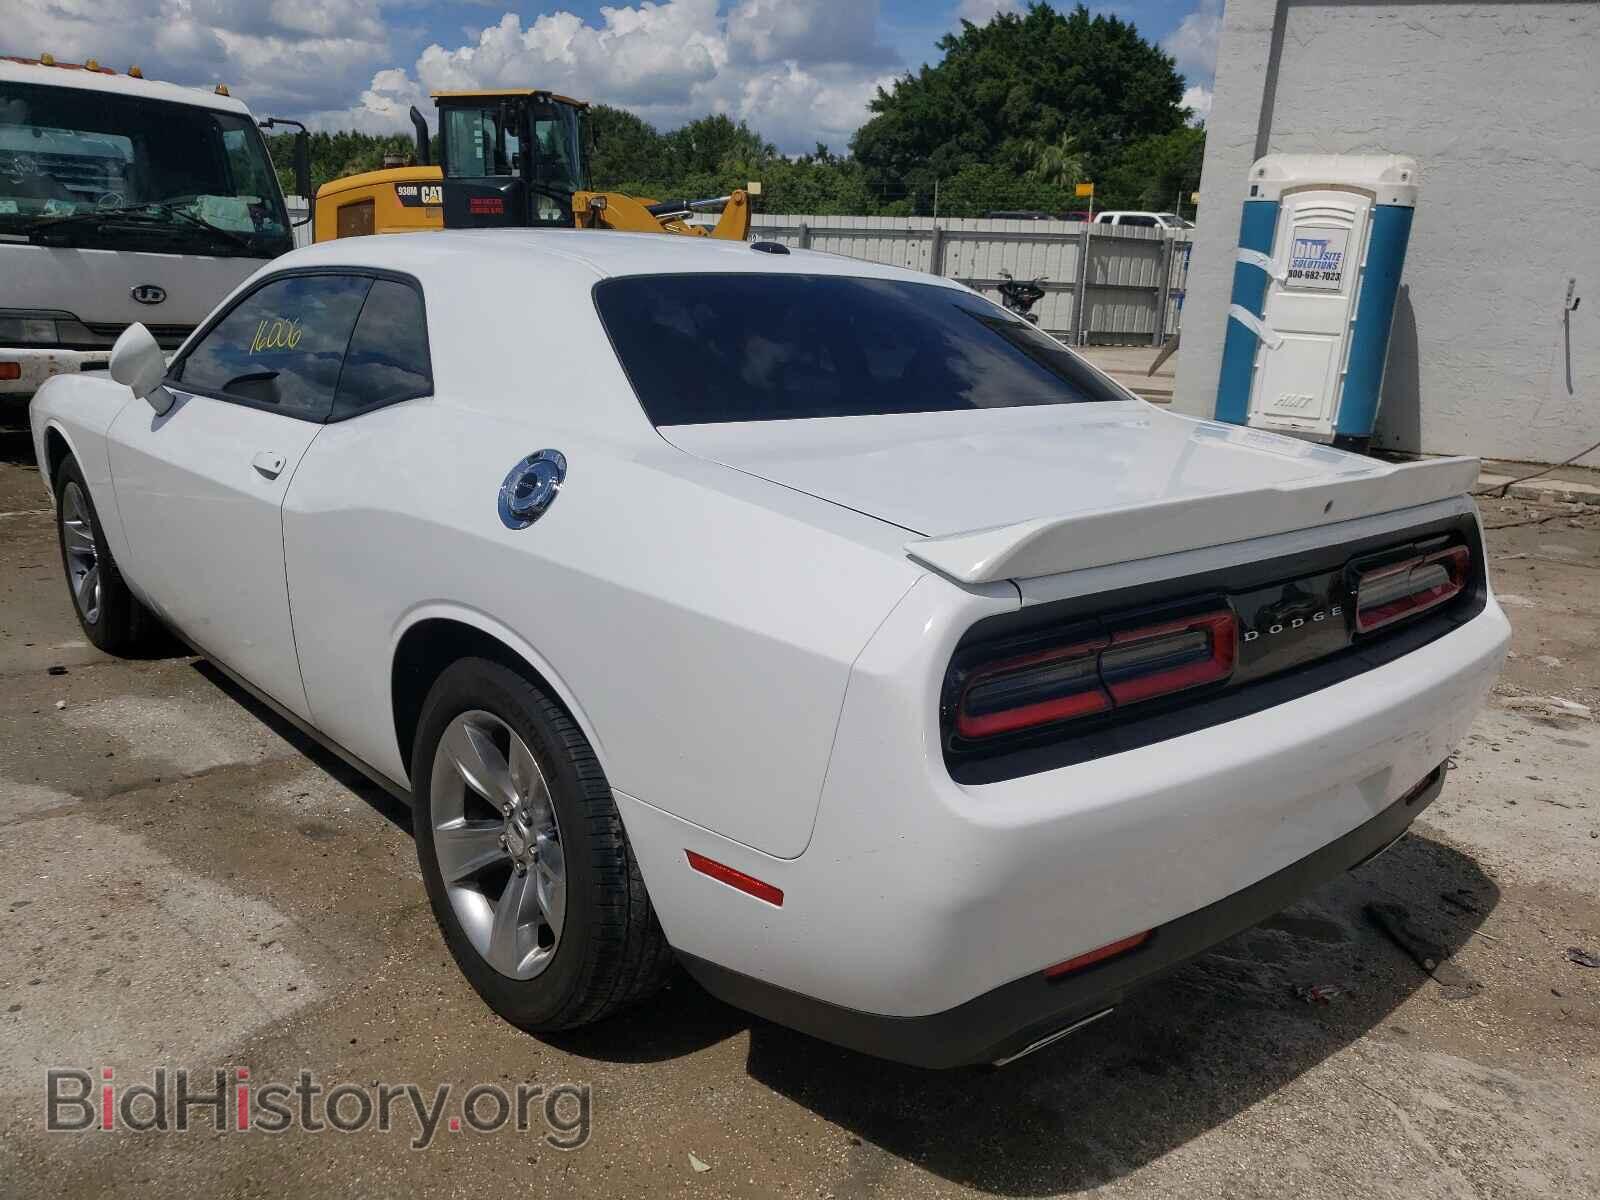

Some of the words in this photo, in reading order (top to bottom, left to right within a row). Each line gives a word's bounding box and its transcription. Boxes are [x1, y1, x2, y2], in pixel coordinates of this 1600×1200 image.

[397, 186, 417, 196] 938M
[421, 186, 443, 204] CAT
[1323, 252, 1343, 261] SITE
[1292, 260, 1338, 270] SOLUTIONS
[1244, 606, 1343, 641] DODGE
